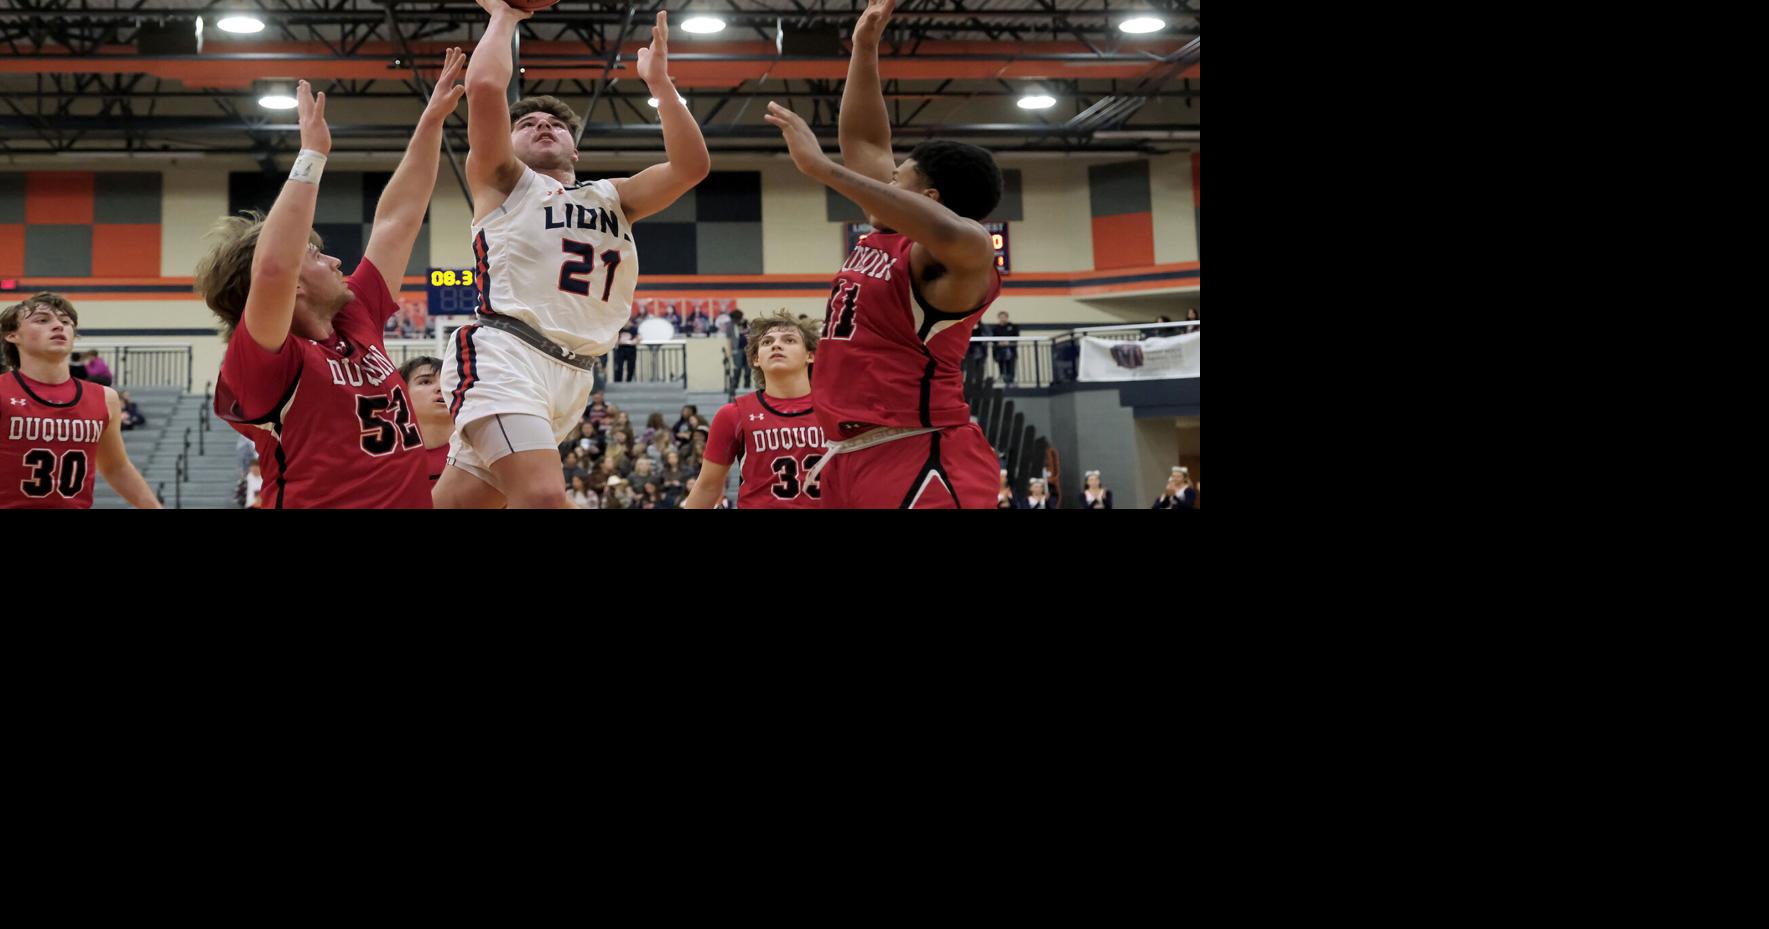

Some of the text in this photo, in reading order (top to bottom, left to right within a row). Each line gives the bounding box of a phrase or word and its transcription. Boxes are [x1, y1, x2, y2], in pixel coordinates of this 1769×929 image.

[544, 203, 632, 242] LION
[431, 270, 473, 286] 08.3
[559, 237, 621, 302] 21
[8, 416, 104, 443] DUQUOIN
[355, 384, 423, 457] 52
[752, 426, 827, 453] DUQUOI
[20, 448, 88, 499] 30
